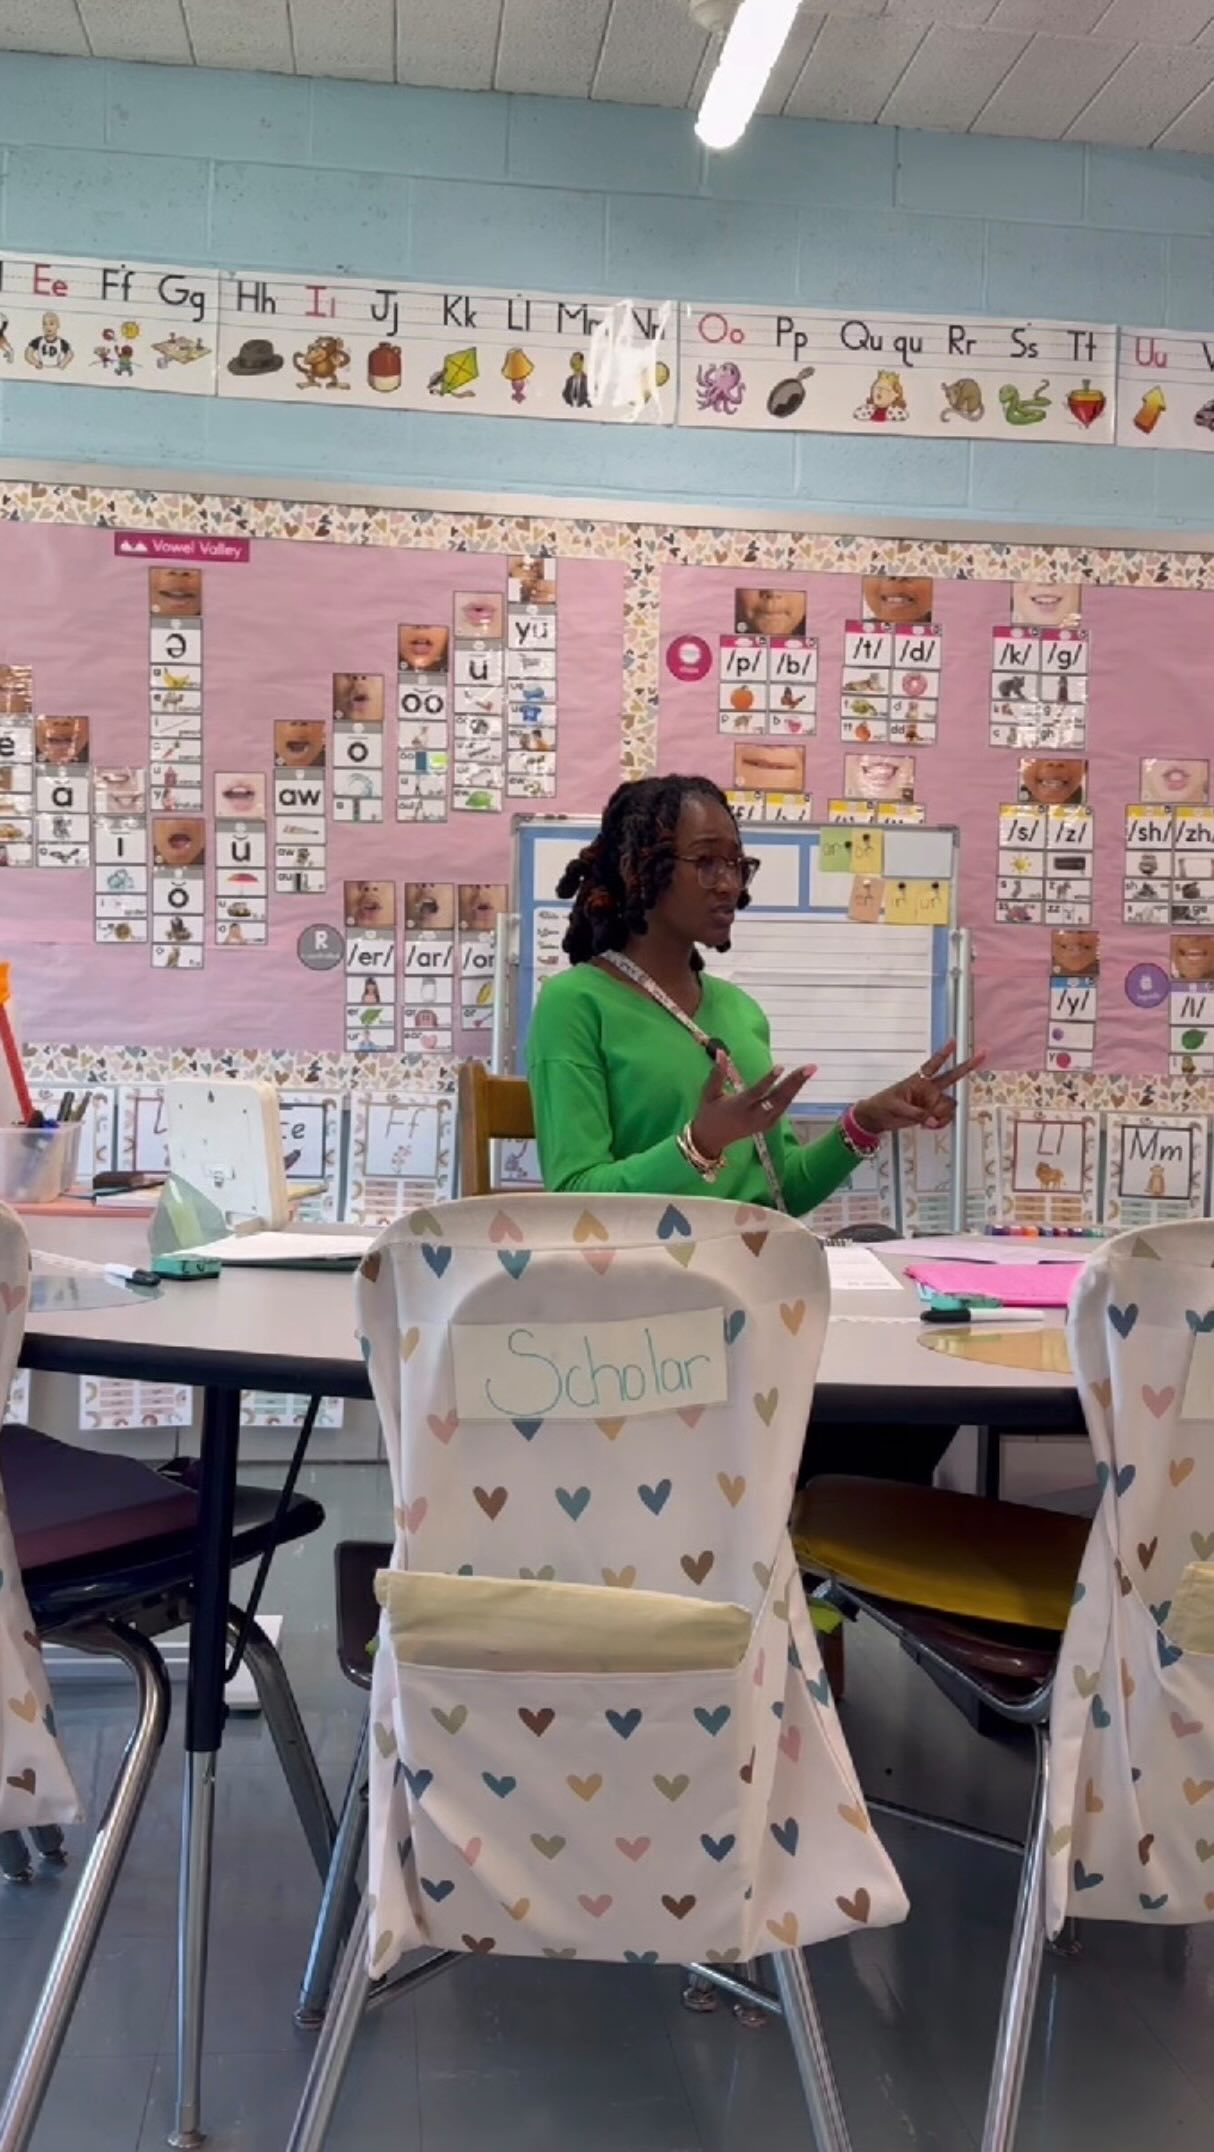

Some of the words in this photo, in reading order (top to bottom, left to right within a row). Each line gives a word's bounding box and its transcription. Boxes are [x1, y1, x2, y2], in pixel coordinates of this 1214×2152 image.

[34, 263, 69, 297] Ee
[102, 268, 136, 301] Ff
[158, 274, 205, 322] Gg
[237, 280, 276, 314] Hh
[371, 289, 398, 337] Jj
[443, 294, 477, 329] Kk
[508, 298, 531, 332] Ll
[699, 312, 745, 344] Oo
[776, 316, 809, 361] Pp
[840, 319, 883, 352] Qu
[893, 333, 923, 368] qu
[948, 324, 977, 356] Rr
[1010, 327, 1039, 359] Ss
[1067, 330, 1098, 361] Tt
[1135, 336, 1168, 368] Uu
[152, 538, 195, 554] Vowel
[200, 541, 242, 559] Valley
[853, 636, 883, 660] /t/
[899, 640, 936, 663] /d/
[999, 643, 1032, 666] /k/
[1047, 642, 1083, 670] /g/
[726, 650, 762, 677] /p/
[776, 652, 812, 676] /b/
[278, 788, 321, 808] aw
[1007, 819, 1040, 842] /s/
[1055, 820, 1087, 843] /z/
[1127, 819, 1172, 842] /sh/
[1175, 820, 1214, 843] /zh
[315, 930, 329, 951] R
[347, 944, 394, 967] /er/
[406, 944, 453, 968] /ar/
[1056, 989, 1090, 1016] /y/
[385, 1105, 426, 1140] Ff
[1129, 1127, 1183, 1161] Mm
[485, 1328, 711, 1416] Scholar
